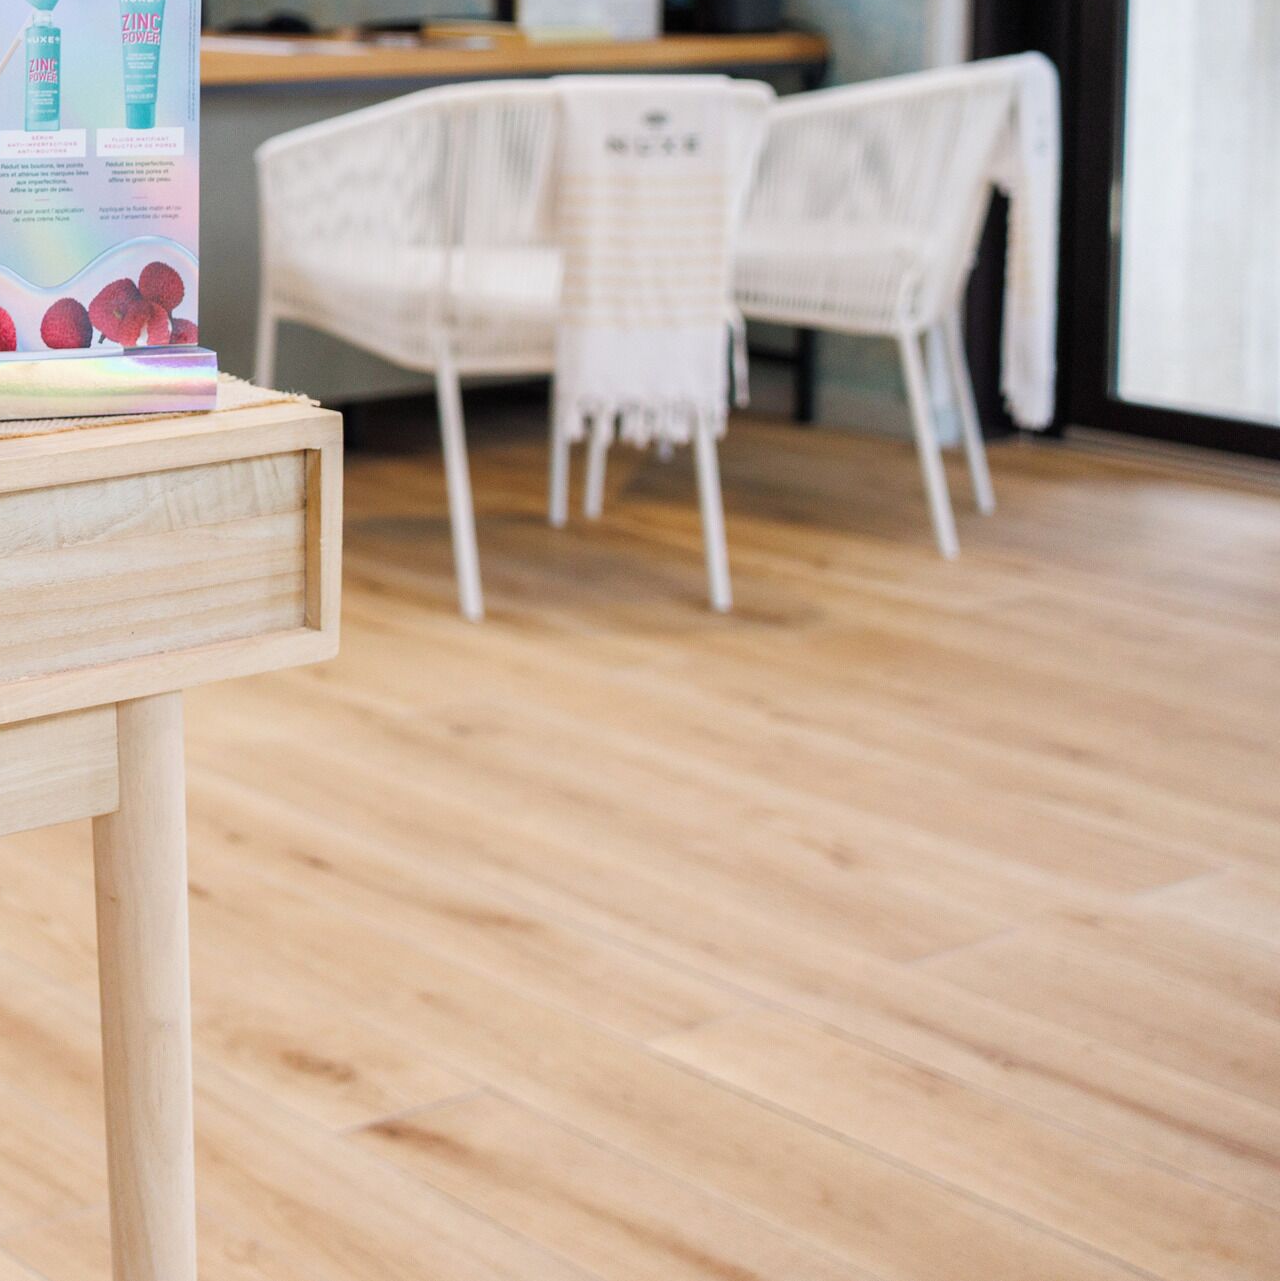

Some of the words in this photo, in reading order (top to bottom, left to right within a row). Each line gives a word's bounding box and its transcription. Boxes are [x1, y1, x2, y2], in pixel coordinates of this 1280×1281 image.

[122, 13, 161, 32] ZINC
[122, 31, 161, 46] POWER
[29, 57, 58, 73] ZINC
[29, 72, 57, 83] POWER
